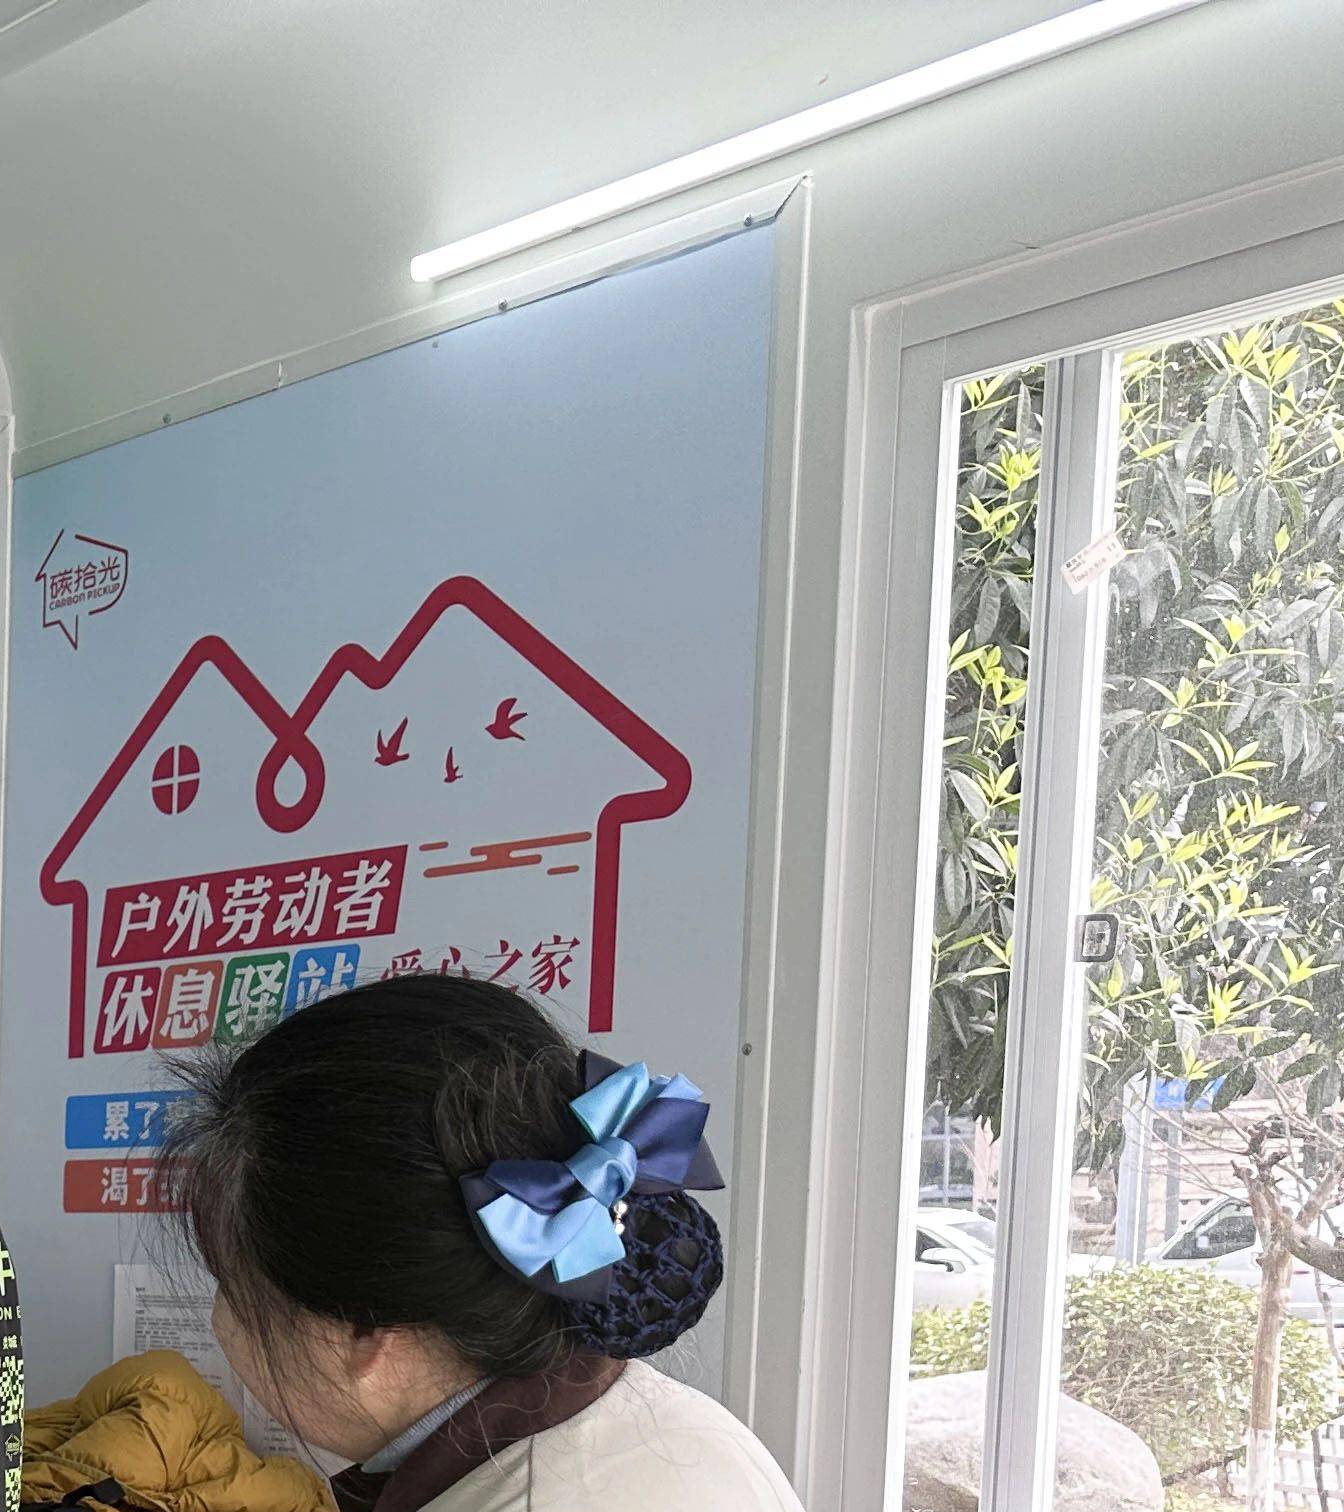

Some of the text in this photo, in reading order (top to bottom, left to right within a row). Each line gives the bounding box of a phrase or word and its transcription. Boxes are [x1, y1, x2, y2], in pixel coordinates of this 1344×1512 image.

[49, 555, 121, 600] 碳拾光
[49, 583, 121, 611] CARBON PICKUP
[111, 859, 393, 958] 户外劳动者
